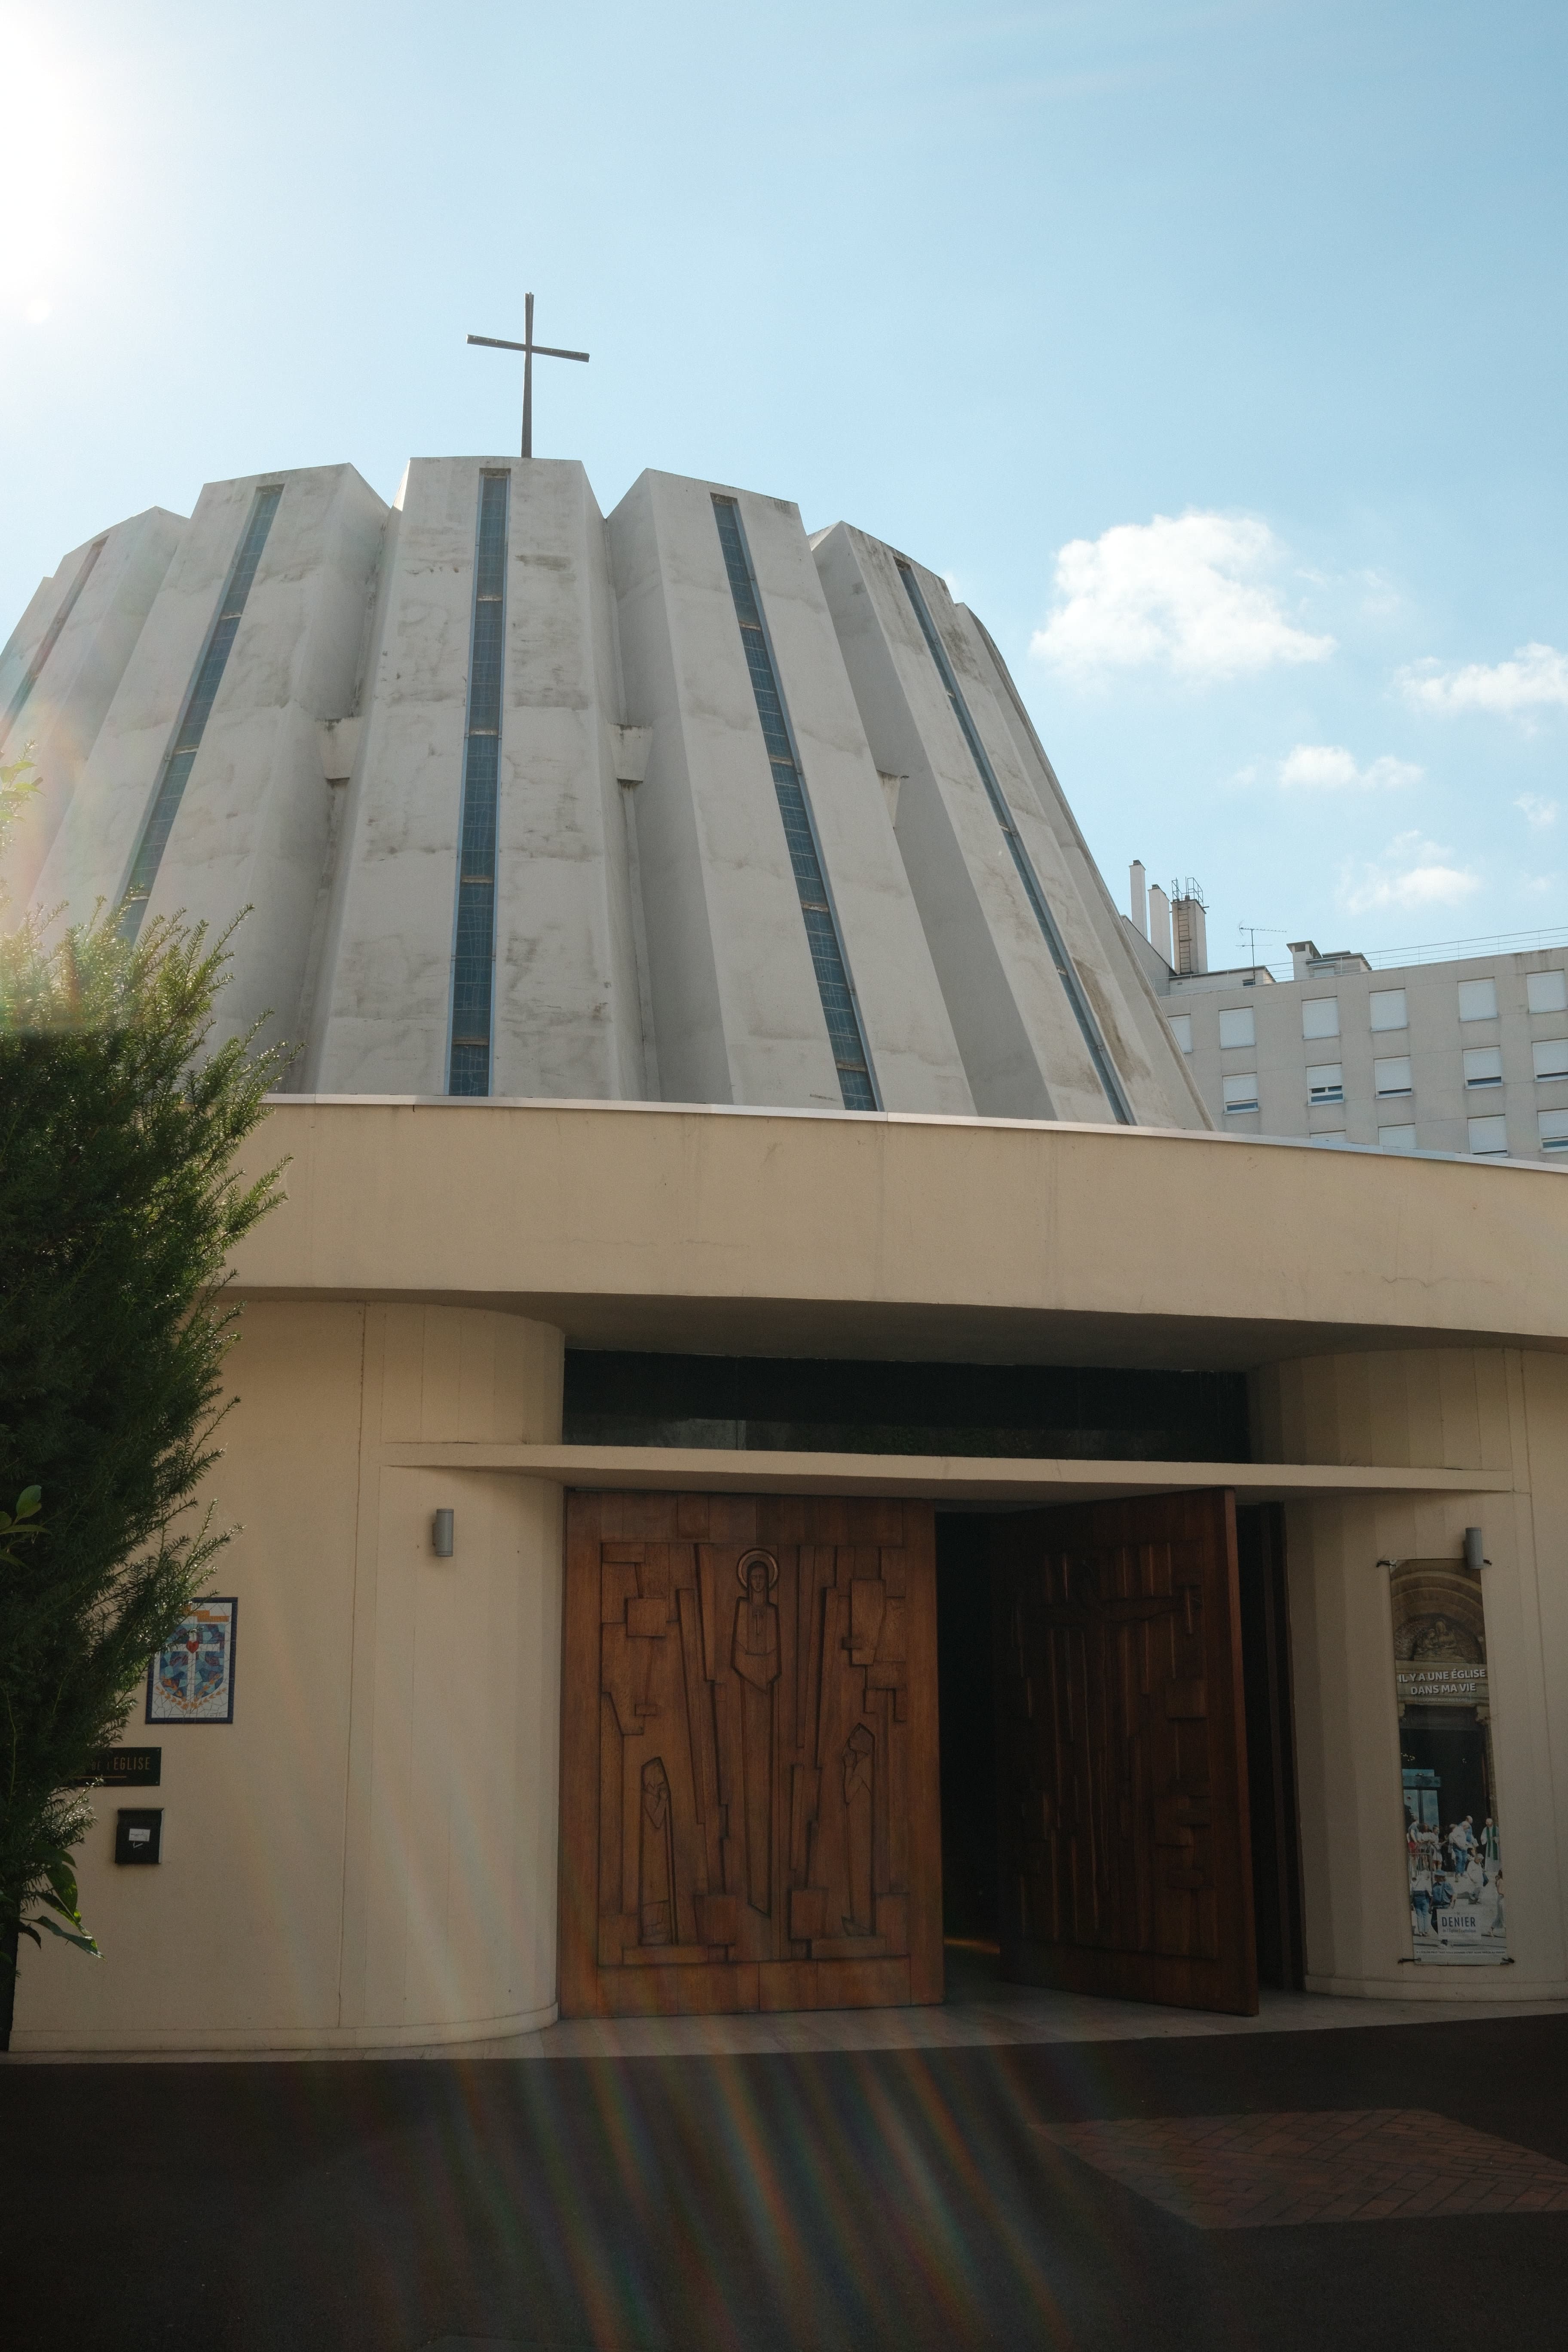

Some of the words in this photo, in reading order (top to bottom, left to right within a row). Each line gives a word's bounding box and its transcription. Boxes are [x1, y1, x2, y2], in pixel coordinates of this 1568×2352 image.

[1399, 1674, 1408, 1682] IL
[1428, 1672, 1449, 1681] UNE
[1451, 1669, 1486, 1679] ÉGLISE
[1410, 1685, 1439, 1695] DANS
[1441, 1684, 1458, 1693] MA
[1460, 1683, 1476, 1692] VIE
[1442, 1917, 1476, 1926] DENIER
